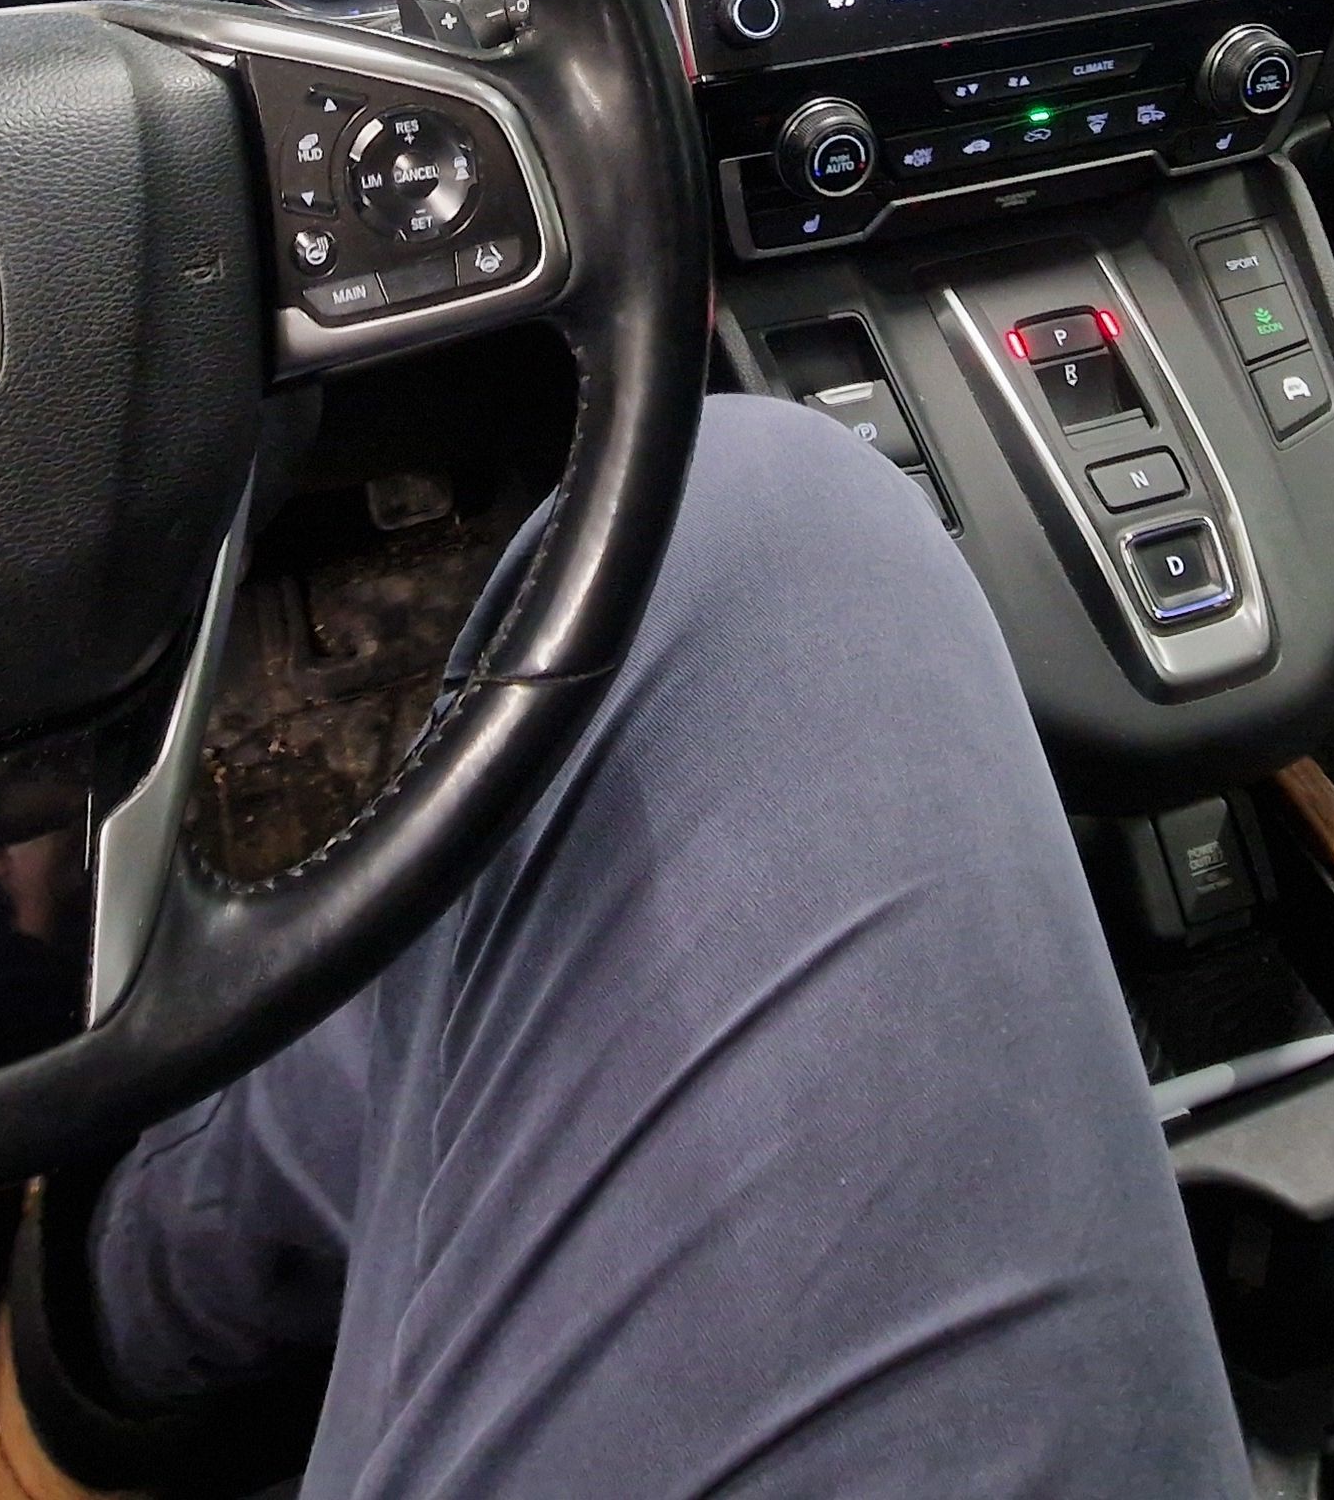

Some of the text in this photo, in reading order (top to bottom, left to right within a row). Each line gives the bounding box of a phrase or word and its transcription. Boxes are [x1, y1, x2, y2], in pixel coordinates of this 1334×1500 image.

[1072, 59, 1116, 77] CLIMATE
[1255, 80, 1282, 93] SYNC
[395, 118, 420, 134] RES
[297, 147, 324, 163] HUD
[393, 162, 440, 184] CANCEL
[825, 160, 855, 175] AUTO
[360, 172, 383, 190] LIM
[410, 215, 435, 232] SET
[1225, 255, 1260, 271] SPORT
[332, 283, 367, 305] MAIN
[1053, 328, 1068, 346] P
[1256, 321, 1284, 336] ECON
[1063, 363, 1079, 382] R
[1130, 470, 1150, 489] N
[1166, 554, 1186, 577] D
